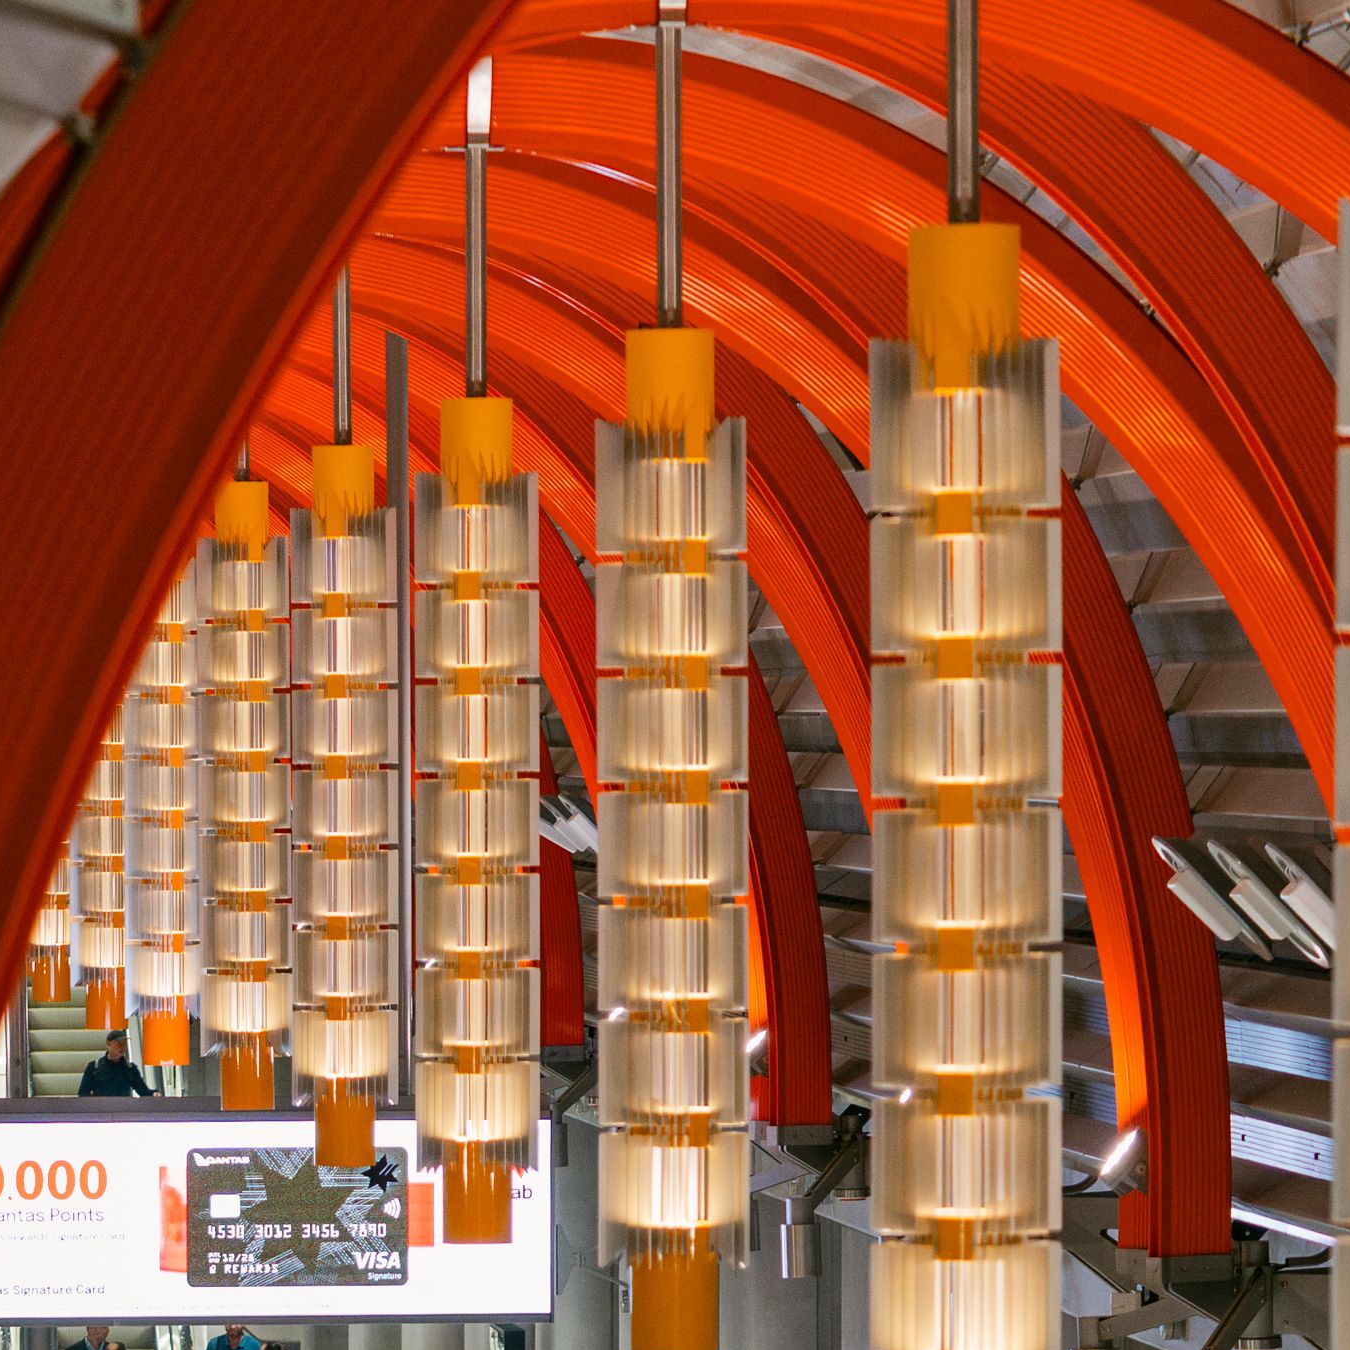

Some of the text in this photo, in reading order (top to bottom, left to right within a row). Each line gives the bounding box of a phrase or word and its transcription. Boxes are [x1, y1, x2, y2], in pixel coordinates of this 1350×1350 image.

[207, 1156, 250, 1165] QANTAS
[50, 1207, 105, 1223] Points
[254, 1223, 292, 1239] 3012
[301, 1223, 340, 1239] 3456
[351, 1251, 402, 1269] VISA
[367, 1272, 402, 1281] Signature
[13, 1284, 73, 1297] Signature
[75, 1284, 105, 1295] Card
